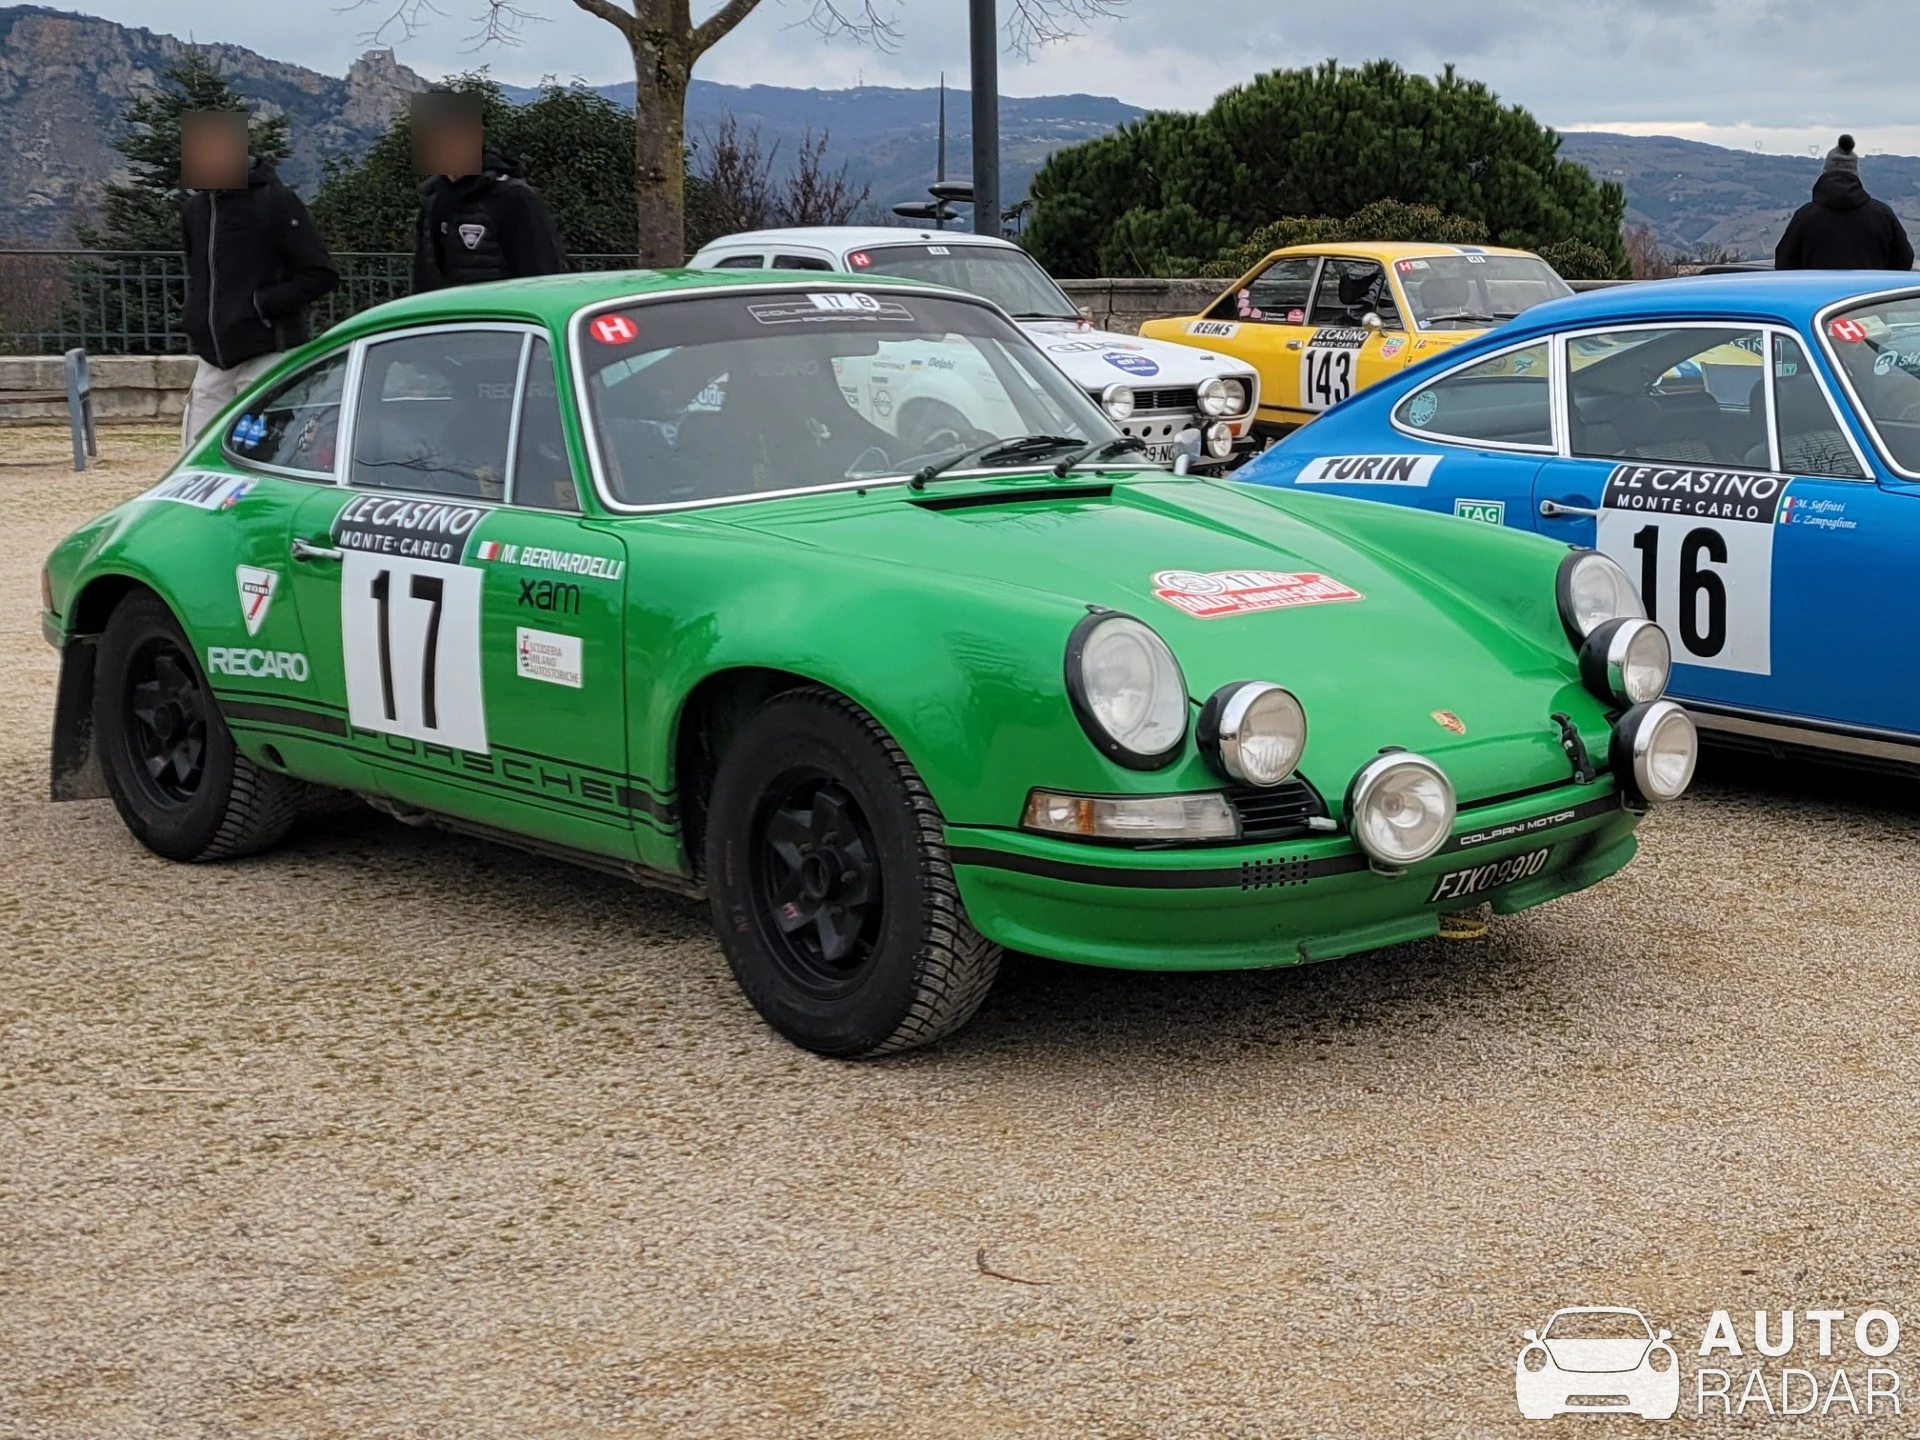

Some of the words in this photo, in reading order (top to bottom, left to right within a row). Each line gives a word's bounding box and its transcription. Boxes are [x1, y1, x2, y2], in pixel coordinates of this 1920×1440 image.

[854, 254, 869, 266] H
[1399, 262, 1411, 271] H
[823, 295, 843, 308] 17
[858, 296, 875, 308] B
[597, 316, 633, 342] H
[1193, 322, 1235, 336] REIMS
[1312, 328, 1326, 340] LE
[1326, 329, 1369, 341] CASINO
[1834, 320, 1864, 340] H
[928, 356, 957, 371] Delphi
[1306, 349, 1351, 406] 143
[1318, 456, 1421, 482] TURIN
[1613, 466, 1646, 489] LE
[1652, 469, 1778, 500] CASINO
[1461, 505, 1498, 523] TAG
[1795, 498, 1807, 509] M.
[1808, 500, 1846, 513] Soffritti
[341, 497, 374, 523] LE
[373, 499, 480, 536] CASINO
[1802, 515, 1857, 530] Zampaglione
[500, 543, 517, 565] M.
[520, 545, 624, 580] BERNARDELLI
[1224, 573, 1262, 587] 17
[517, 577, 580, 616] xam
[1633, 524, 1728, 658] 16
[1166, 594, 1246, 612] RALLYE
[370, 569, 445, 730] 17
[529, 641, 563, 657] SCUDERIA
[207, 646, 309, 682] RECARO
[529, 653, 557, 668] MILANO
[527, 664, 580, 684] AUTOSTORICHE
[350, 725, 615, 803] PORSCHE
[1460, 824, 1525, 846] COLPANI
[1527, 809, 1576, 830] MOTORI
